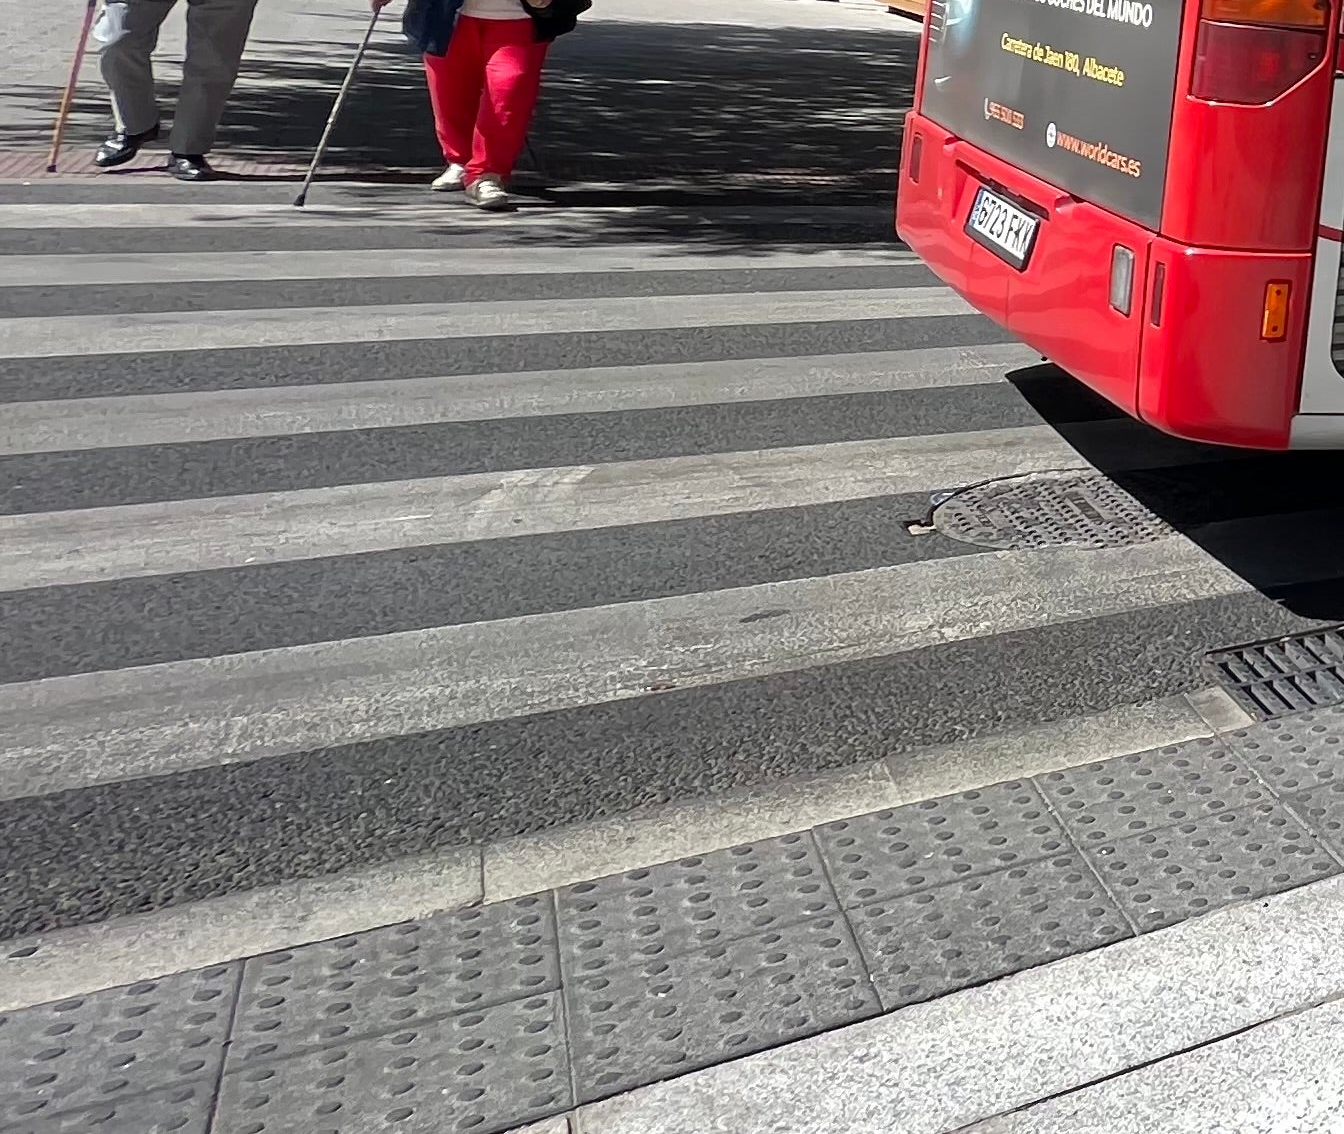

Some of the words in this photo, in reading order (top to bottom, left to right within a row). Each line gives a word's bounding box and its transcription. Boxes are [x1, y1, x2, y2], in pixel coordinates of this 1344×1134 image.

[1033, 42, 1044, 62] de
[1082, 56, 1125, 87] Albacete
[1056, 130, 1142, 178] www.worldcars.es
[978, 196, 1008, 238] 6723
